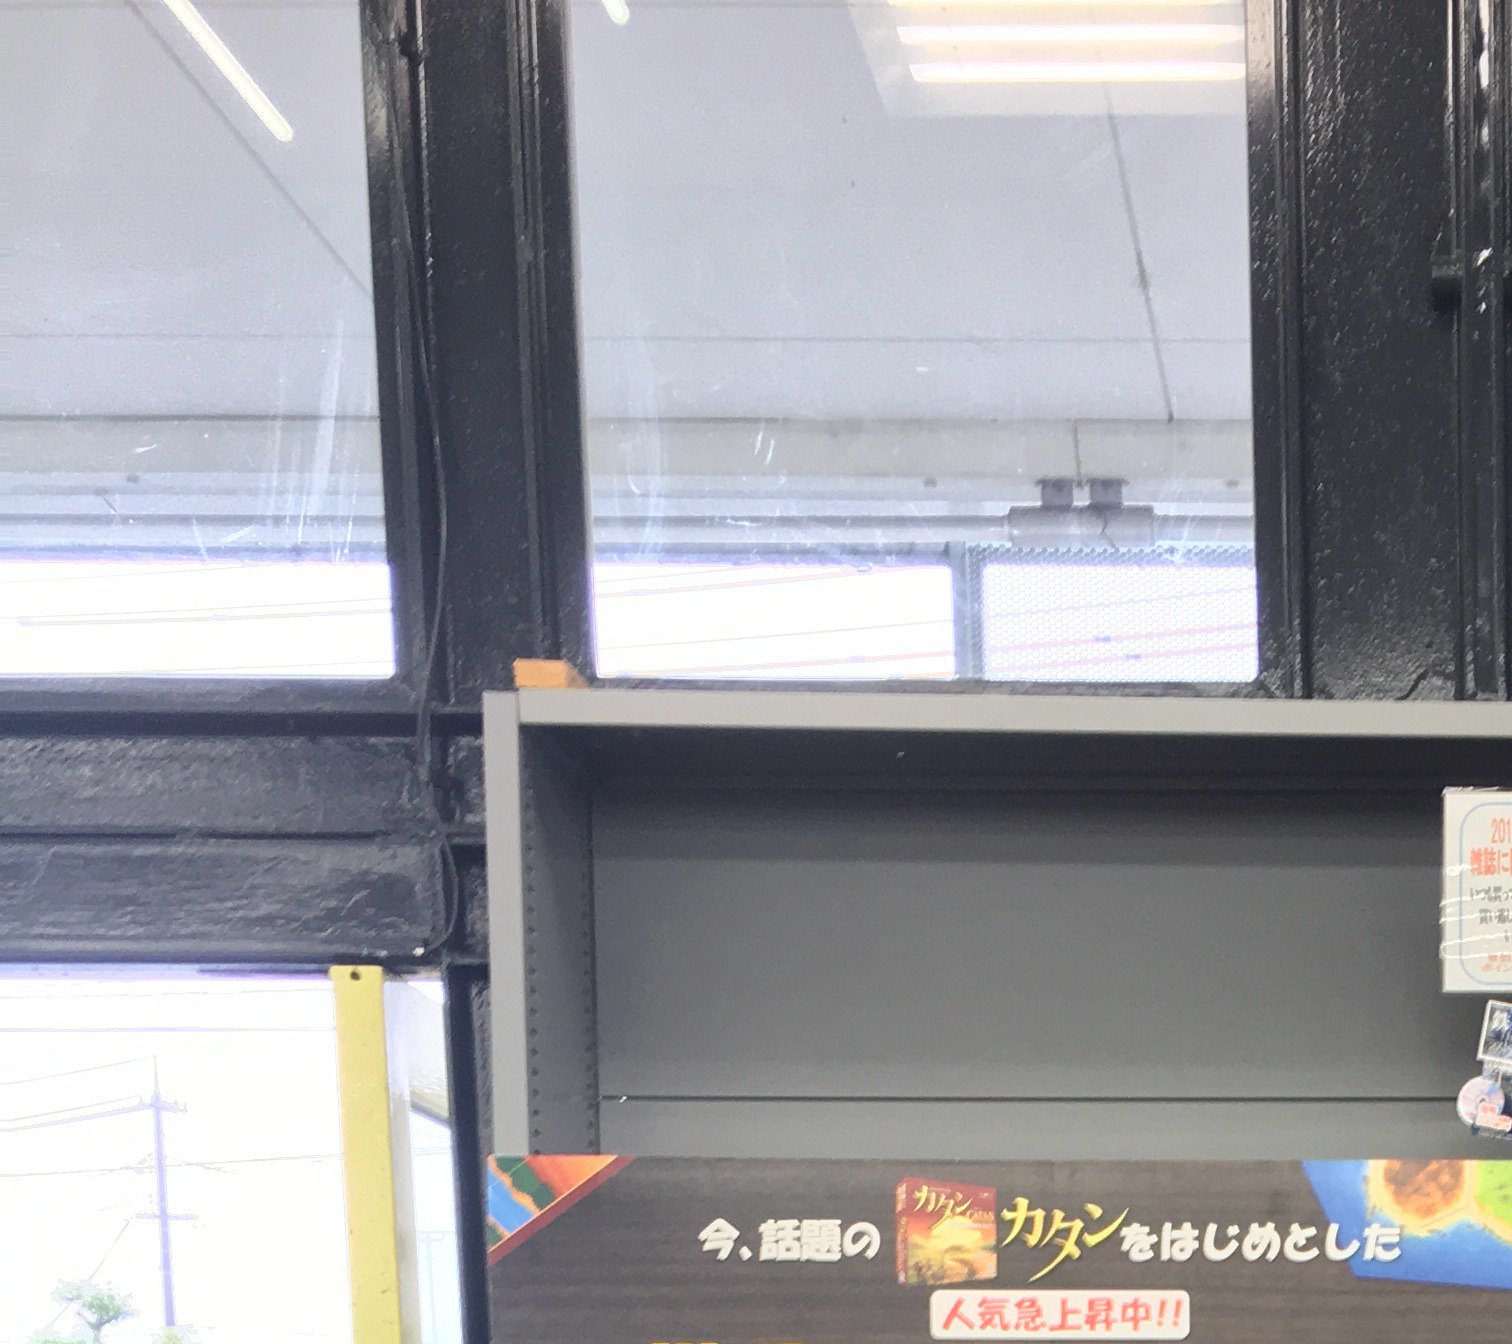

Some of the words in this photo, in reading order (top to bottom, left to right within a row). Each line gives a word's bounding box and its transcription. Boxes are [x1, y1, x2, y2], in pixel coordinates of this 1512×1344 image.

[698, 1217, 882, 1263] 今、話題の
[1000, 1195, 1131, 1283] カタン
[1118, 1221, 1402, 1263] をはじめとした
[942, 1296, 1184, 1332] 人気急上昇中!!
